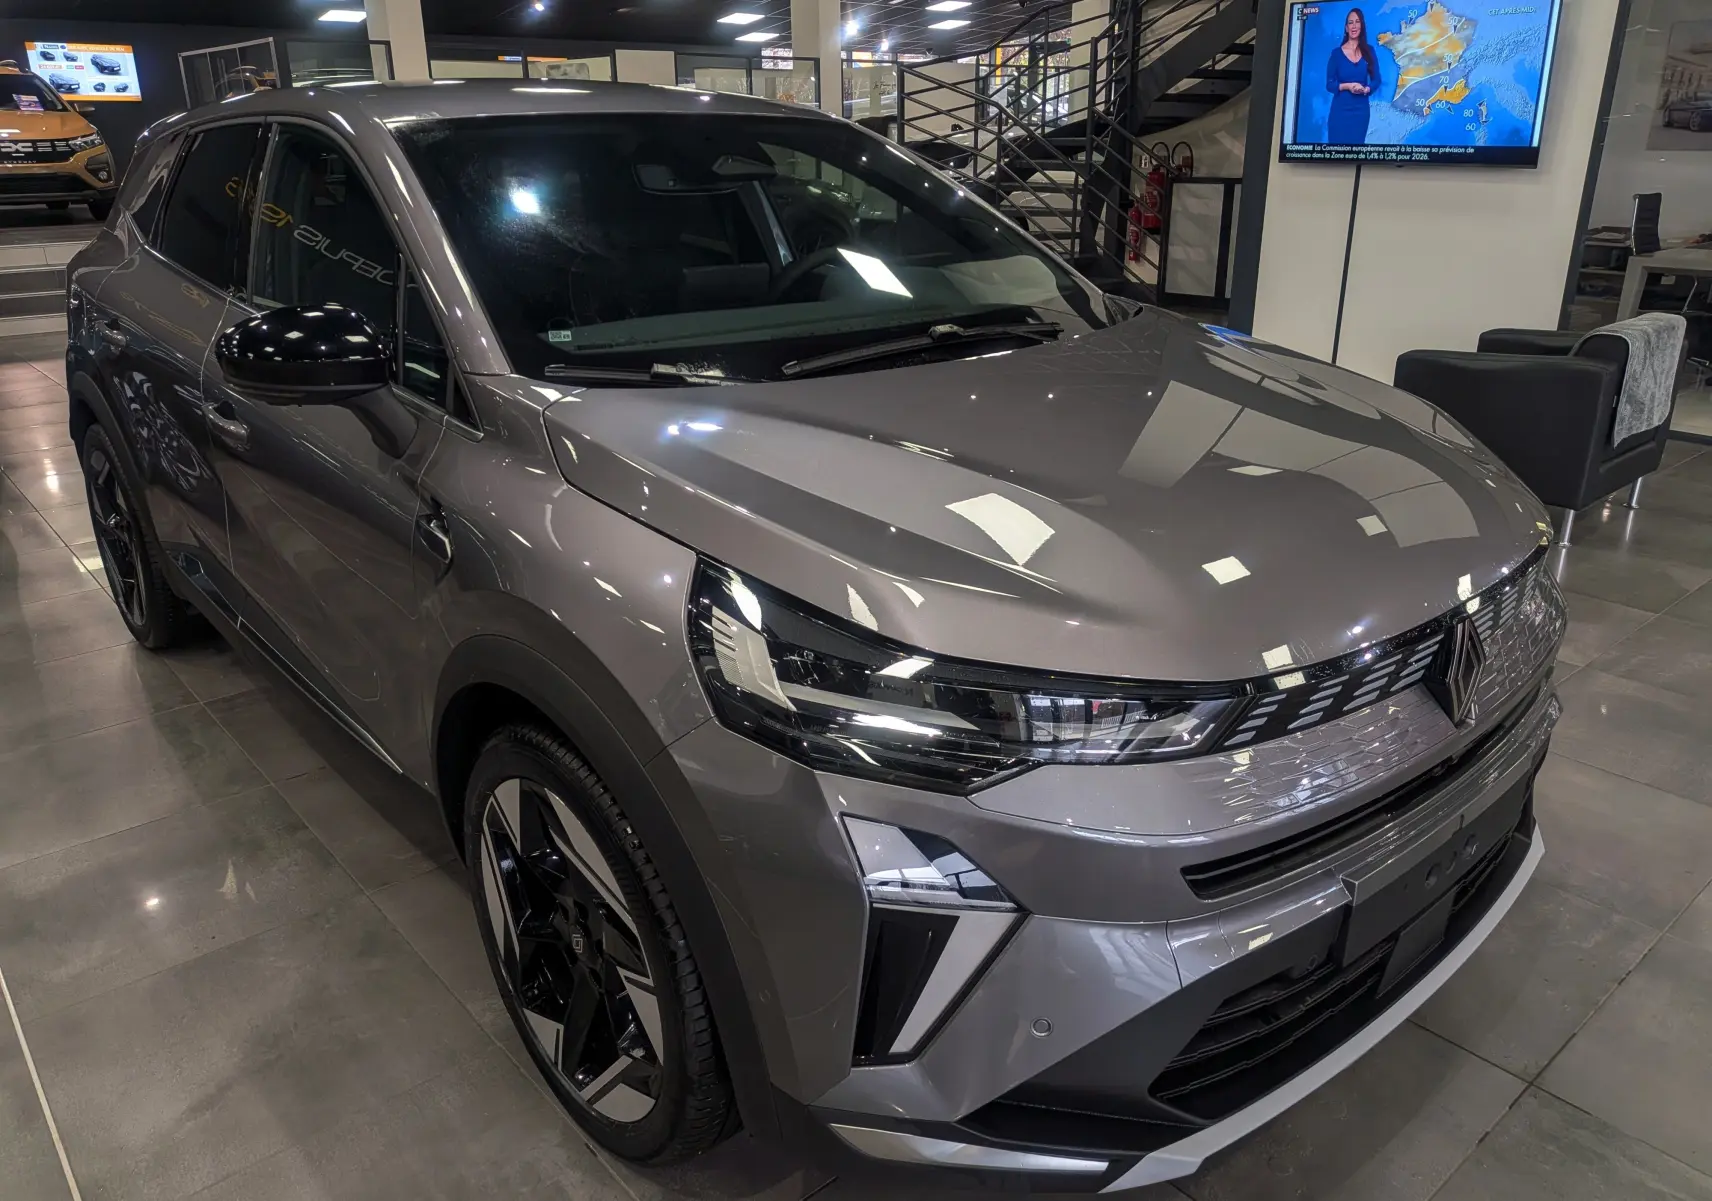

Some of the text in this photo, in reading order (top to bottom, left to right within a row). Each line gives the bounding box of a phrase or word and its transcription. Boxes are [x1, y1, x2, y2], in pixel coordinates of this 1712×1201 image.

[1408, 10, 1418, 18] 50
[1448, 16, 1458, 24] 50
[1443, 54, 1453, 62] 50
[1439, 76, 1449, 84] 70
[1463, 109, 1474, 117] 80
[1466, 123, 1476, 131] 60
